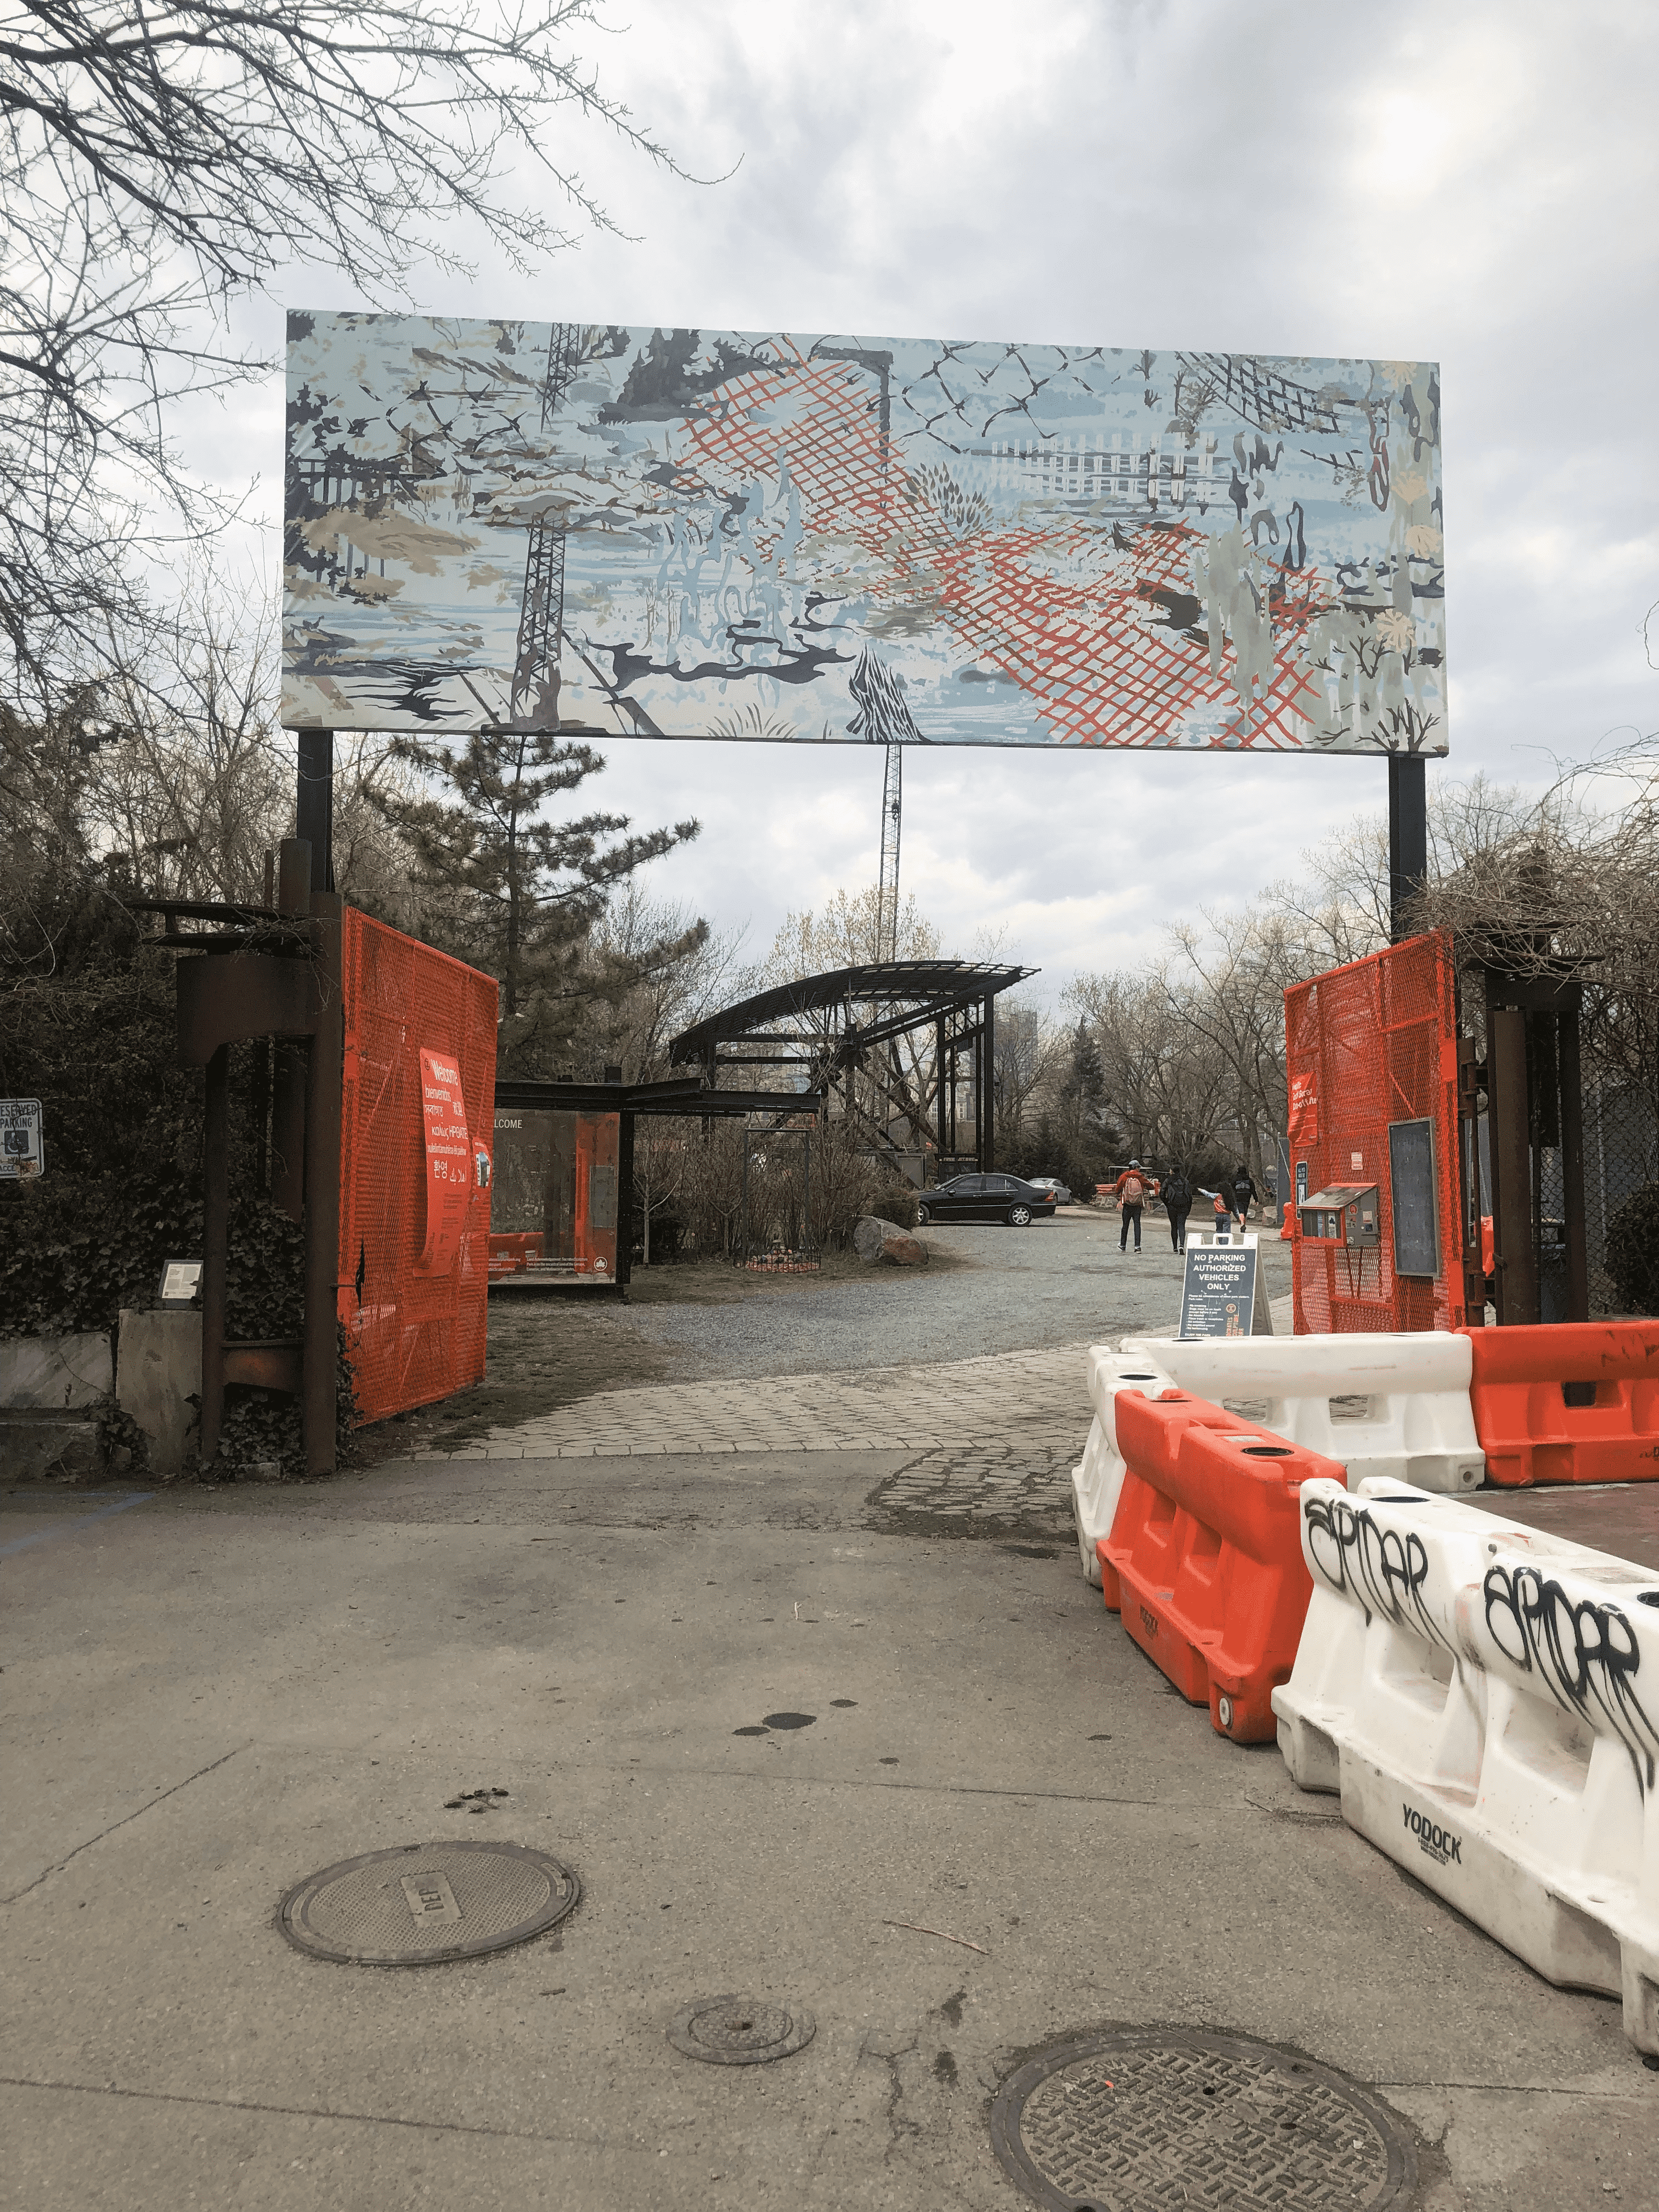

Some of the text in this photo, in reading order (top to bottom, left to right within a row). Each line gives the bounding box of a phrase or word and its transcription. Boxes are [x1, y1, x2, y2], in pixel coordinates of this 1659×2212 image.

[430, 1059, 459, 1086] Welcome
[0, 1104, 37, 1116] ESERVED
[494, 1119, 523, 1128] LCOME
[433, 1160, 448, 1180] 환영
[1403, 1803, 1462, 1865] YODOCK
[419, 1888, 445, 1912] DEP
[1097, 2132, 1212, 2203] SEWER
